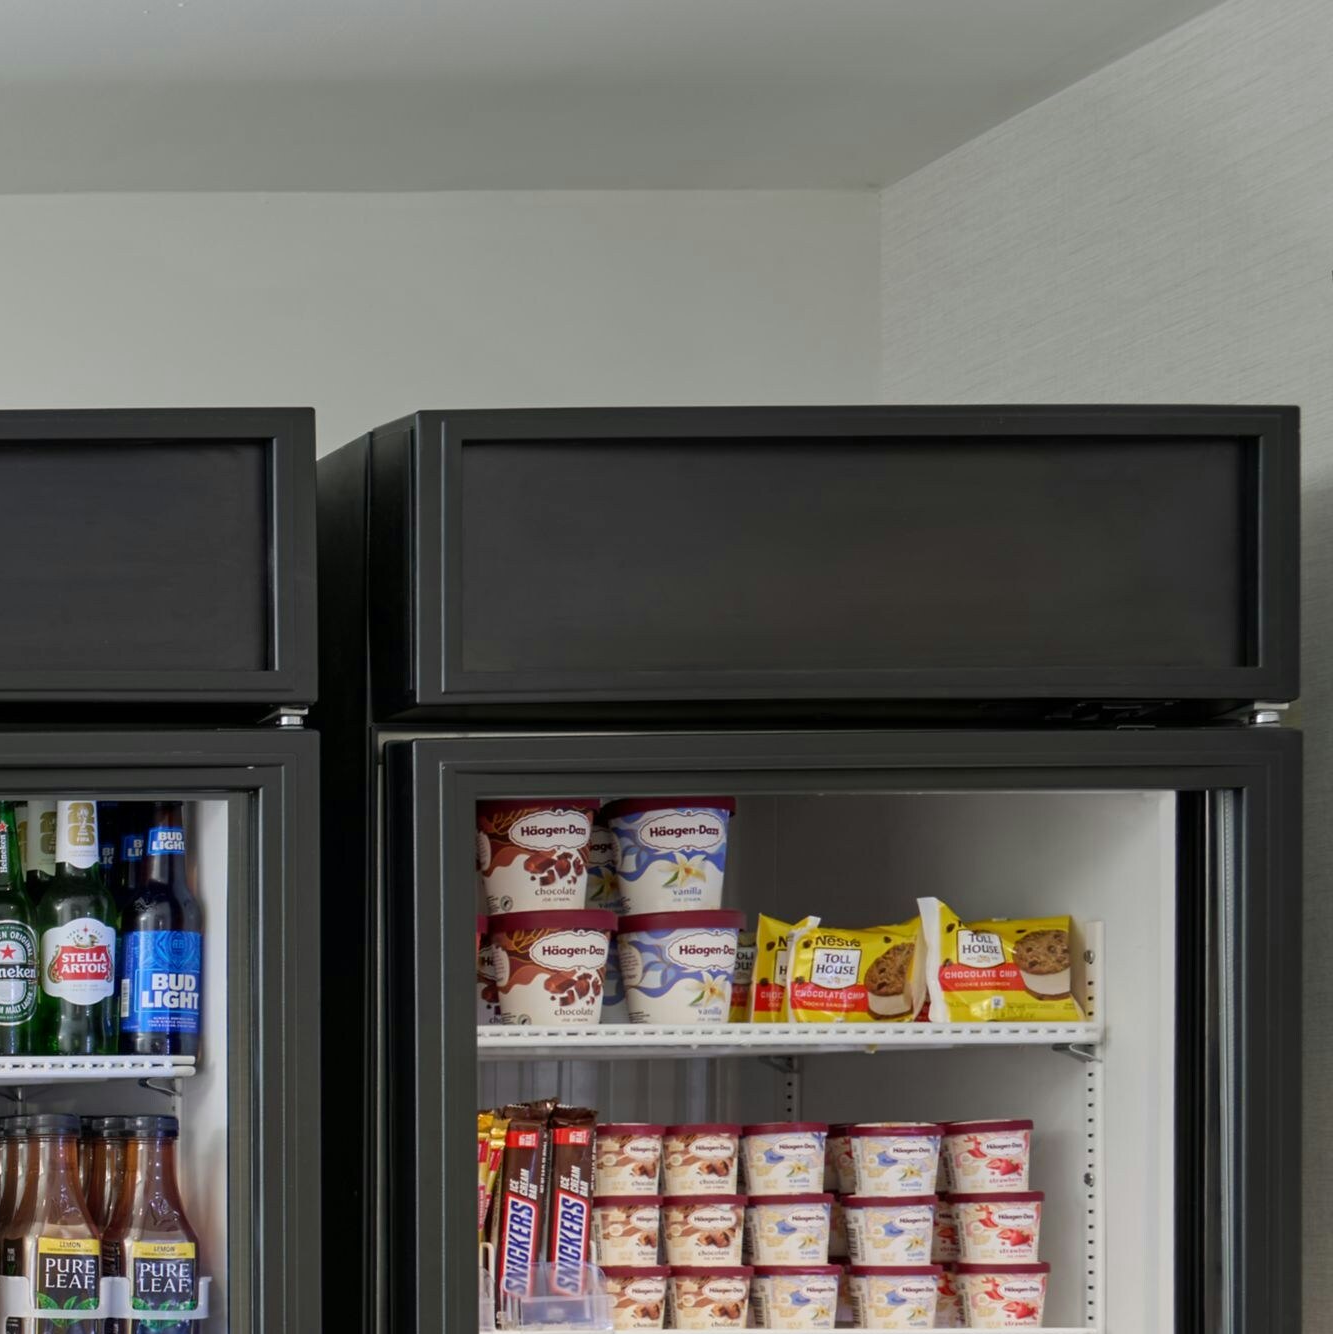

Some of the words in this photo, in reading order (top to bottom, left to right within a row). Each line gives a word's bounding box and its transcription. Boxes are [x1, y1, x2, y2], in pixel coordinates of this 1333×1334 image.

[535, 886, 576, 895] chocolate
[62, 952, 107, 964] STELLA
[824, 953, 851, 964] TOLL
[61, 963, 107, 973] ARTOIS
[817, 964, 856, 975] HOUSE
[152, 973, 196, 990] BUD
[142, 990, 198, 1009] LIGHT
[795, 989, 843, 999] CHOCOLATE
[505, 1199, 533, 1295] SNICKERS
[45, 1258, 96, 1274] PURE
